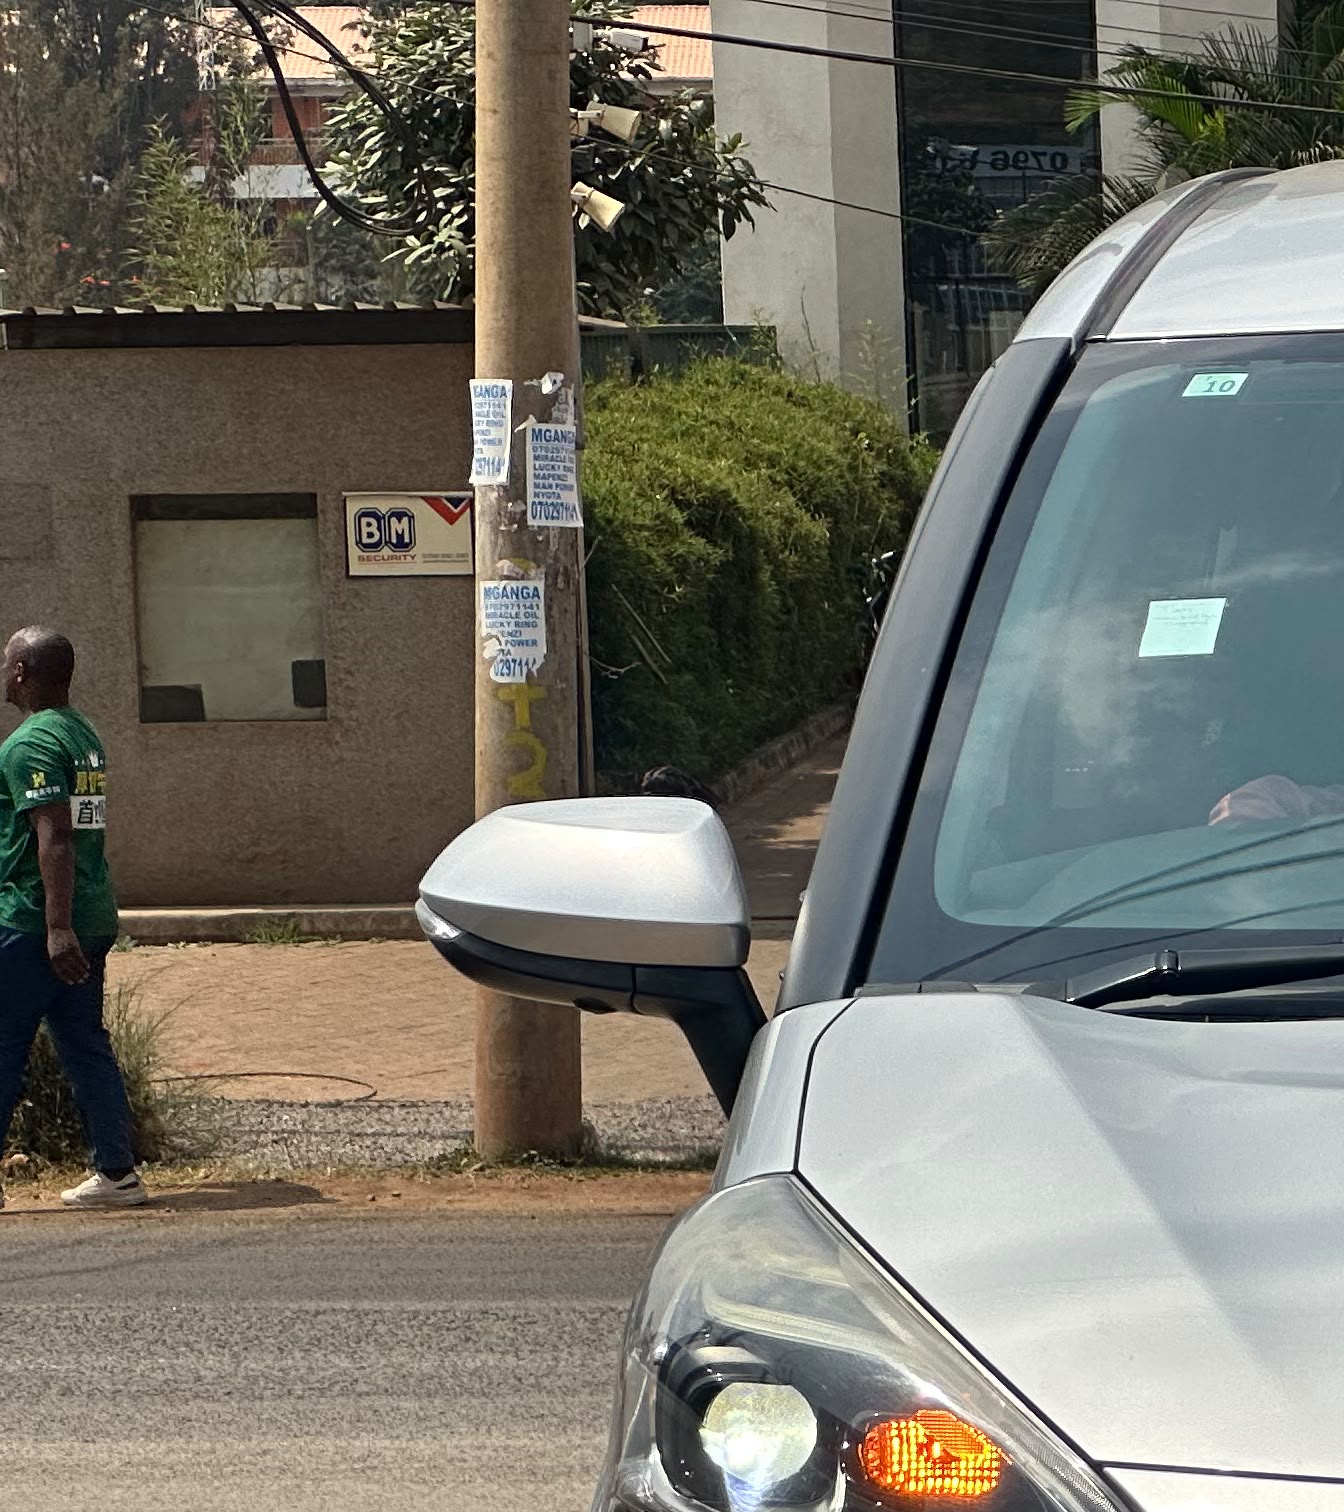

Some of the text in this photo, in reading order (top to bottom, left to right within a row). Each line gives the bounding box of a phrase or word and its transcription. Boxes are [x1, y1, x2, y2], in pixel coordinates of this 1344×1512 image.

[358, 554, 416, 562] SECURITY
[484, 585, 541, 600] MGANGA
[523, 611, 540, 620] OIL
[514, 621, 538, 629] RING
